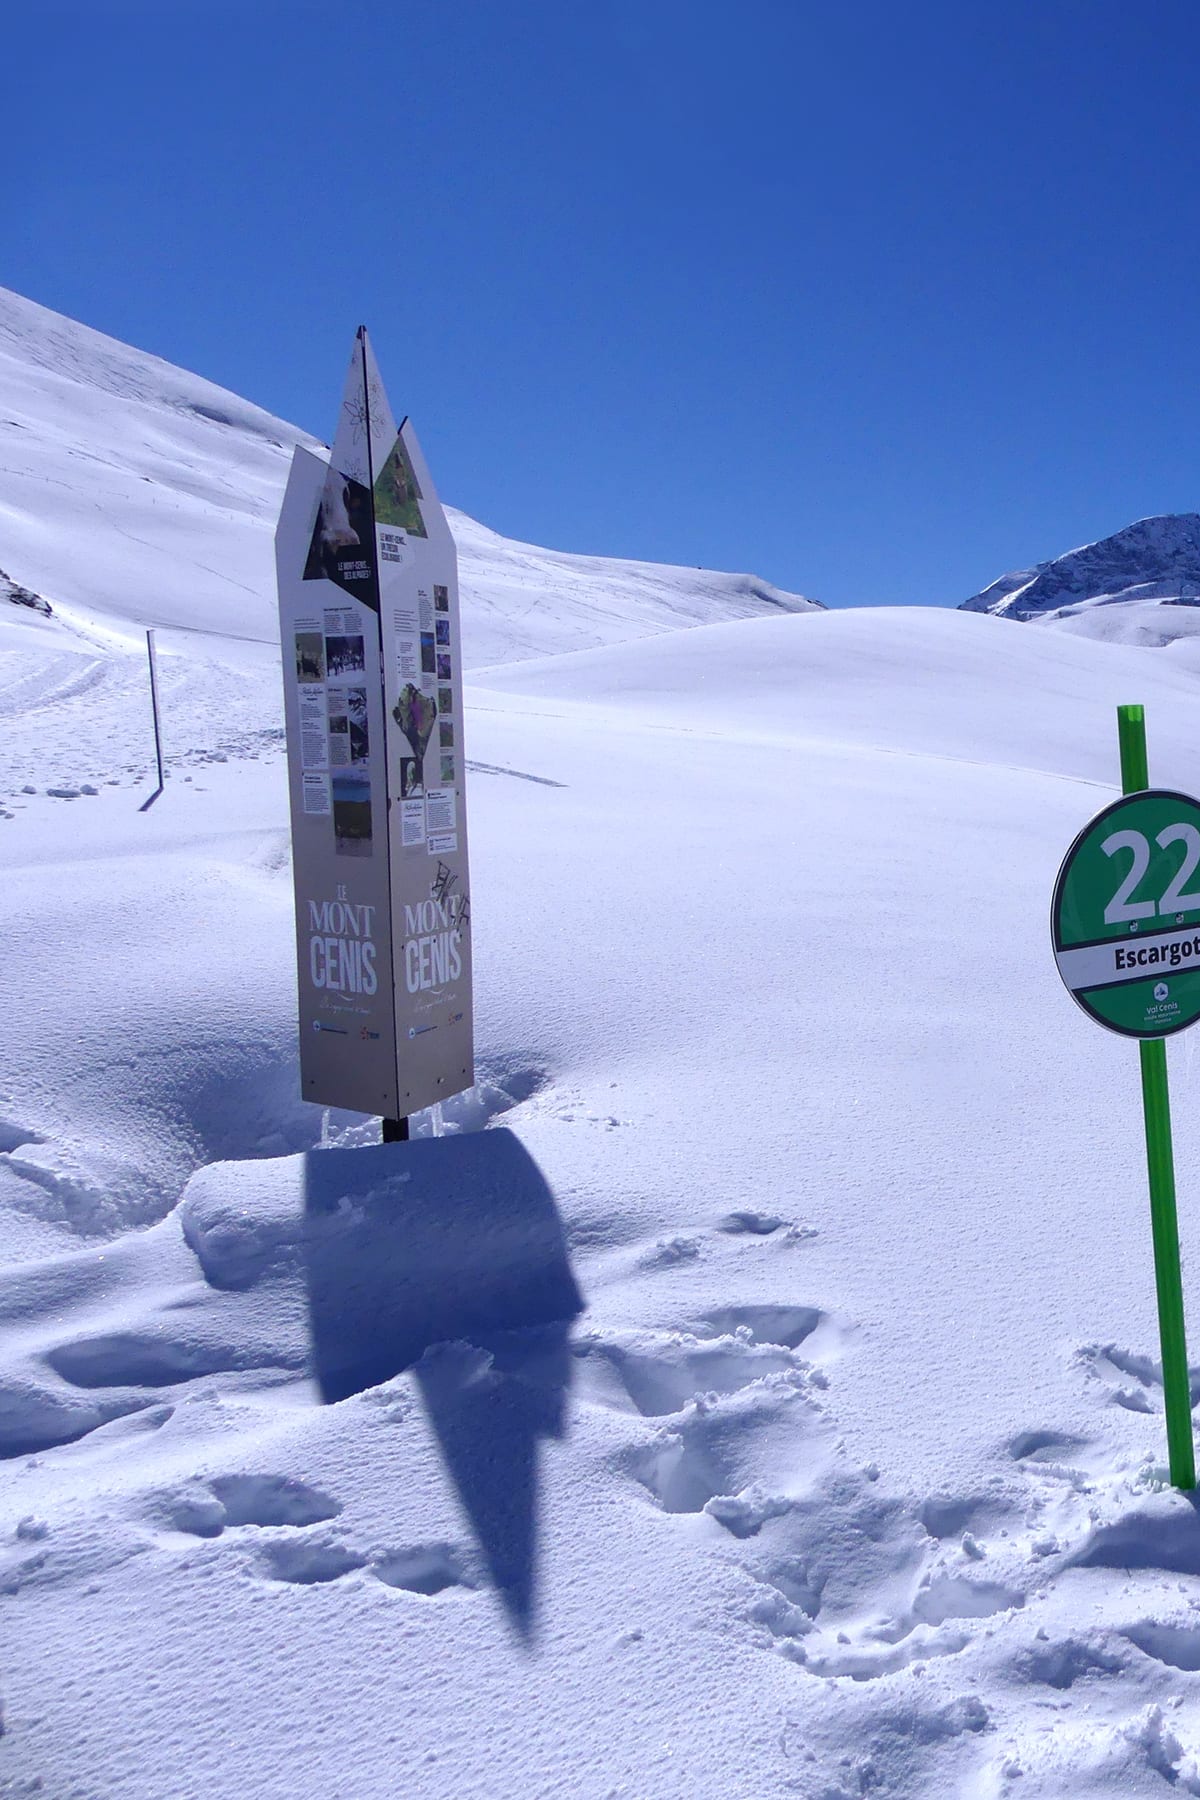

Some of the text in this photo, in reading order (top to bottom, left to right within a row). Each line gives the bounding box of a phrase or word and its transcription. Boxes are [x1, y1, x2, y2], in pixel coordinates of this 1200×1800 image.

[337, 884, 348, 901] LE
[307, 899, 376, 938] MONT
[404, 894, 461, 937] MONT
[310, 935, 379, 996] CENIS
[405, 928, 462, 994] CENIS
[1146, 1004, 1158, 1015] Val
